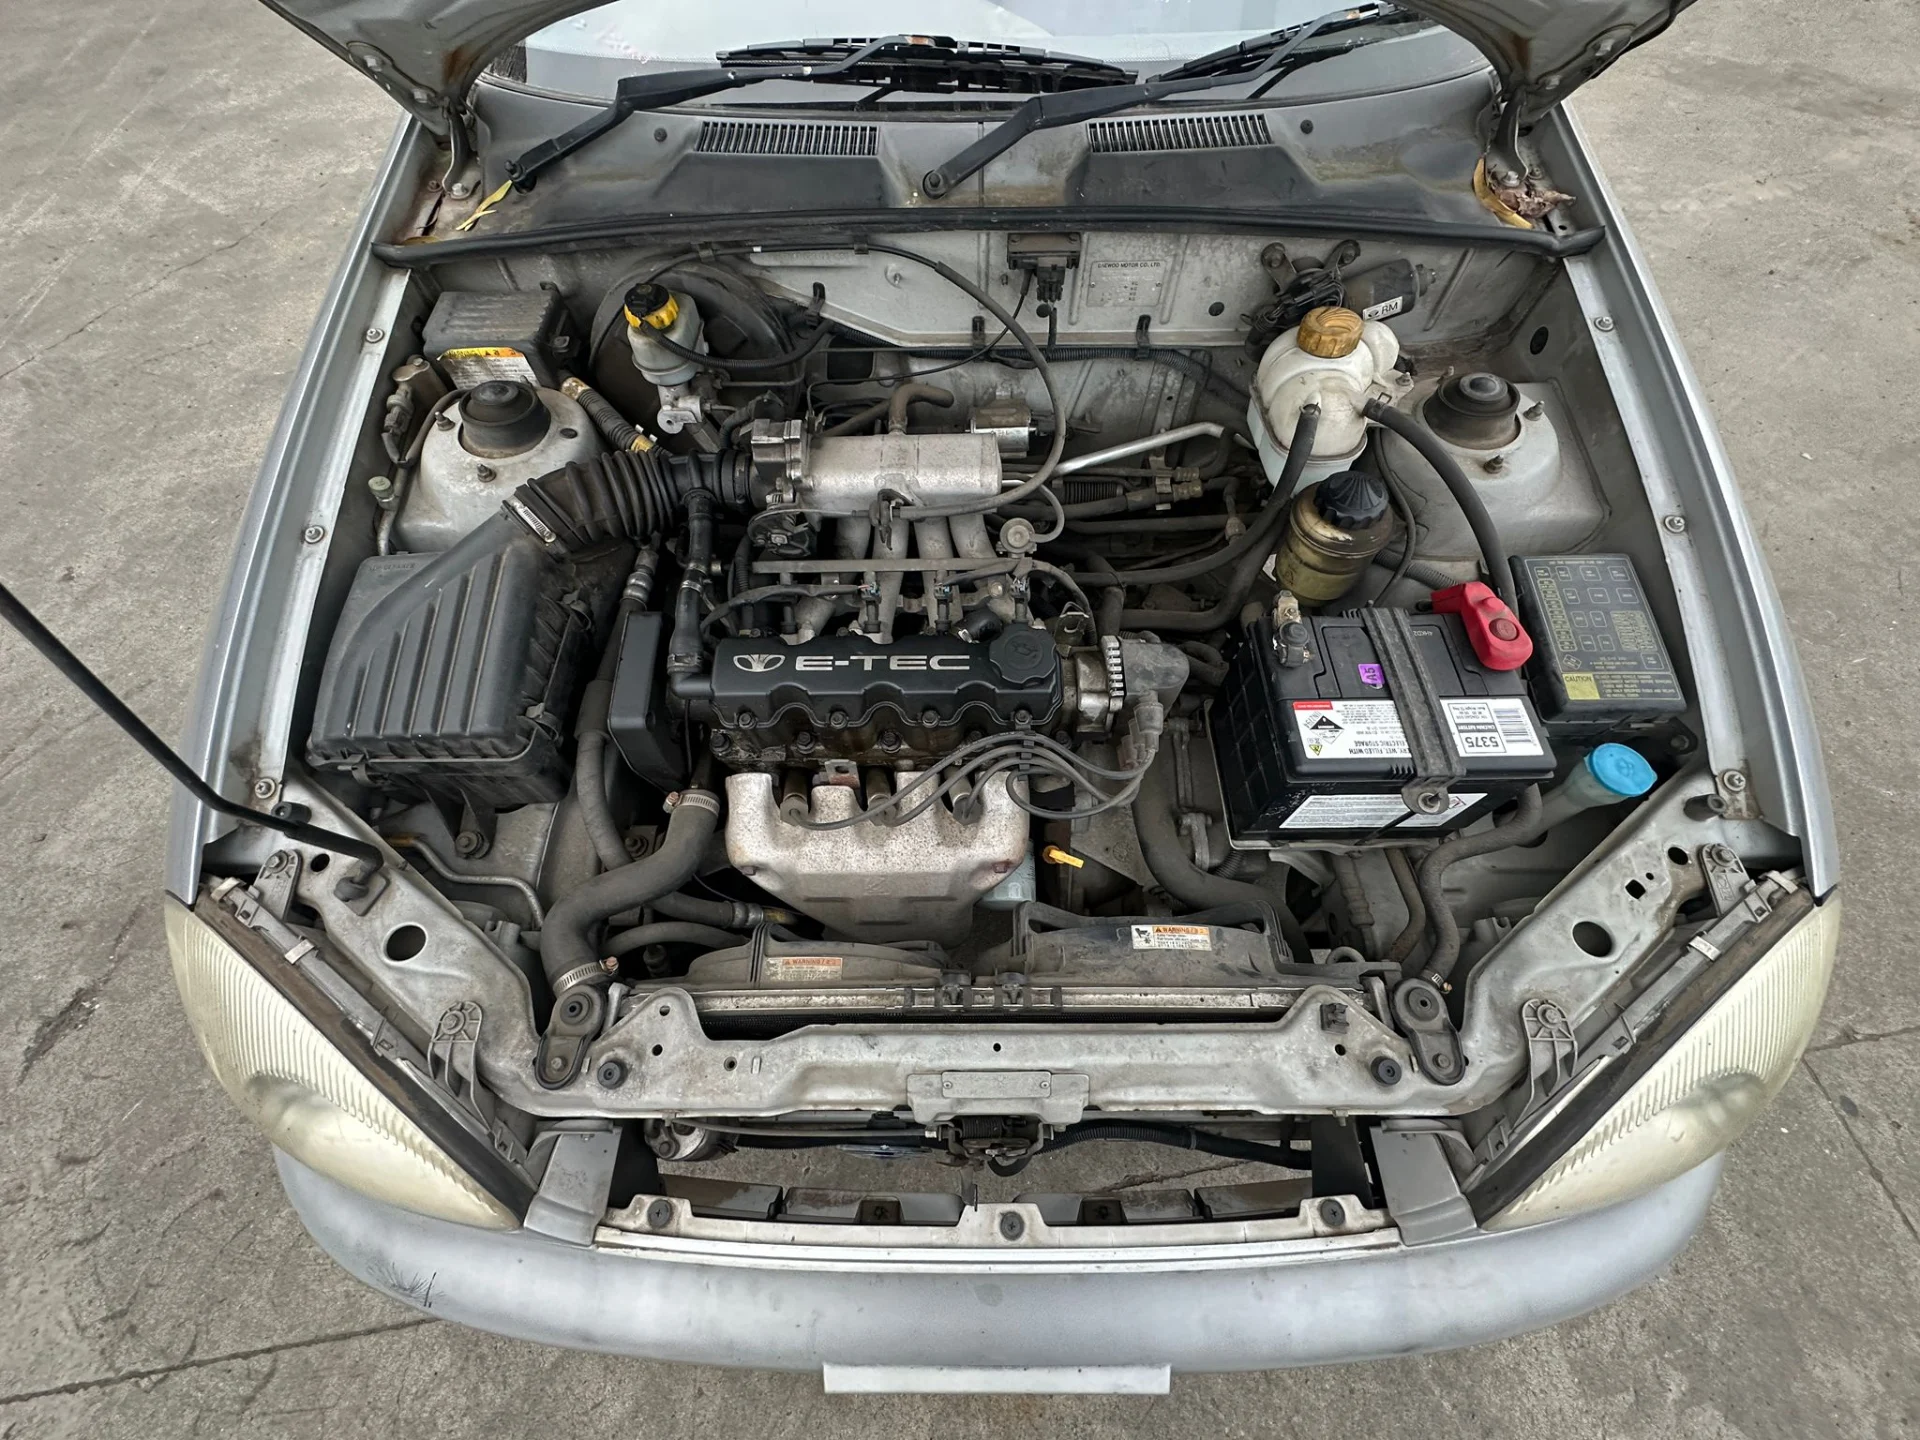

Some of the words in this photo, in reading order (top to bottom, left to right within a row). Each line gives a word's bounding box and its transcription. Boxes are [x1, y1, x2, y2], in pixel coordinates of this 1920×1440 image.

[1381, 301, 1398, 315] RM
[795, 654, 970, 671] E-TEC
[1364, 667, 1377, 681] A5
[1565, 675, 1592, 683] CAUTION
[1465, 736, 1499, 748] 5375
[1348, 747, 1364, 755] WITH
[1364, 747, 1383, 755] FILLED
